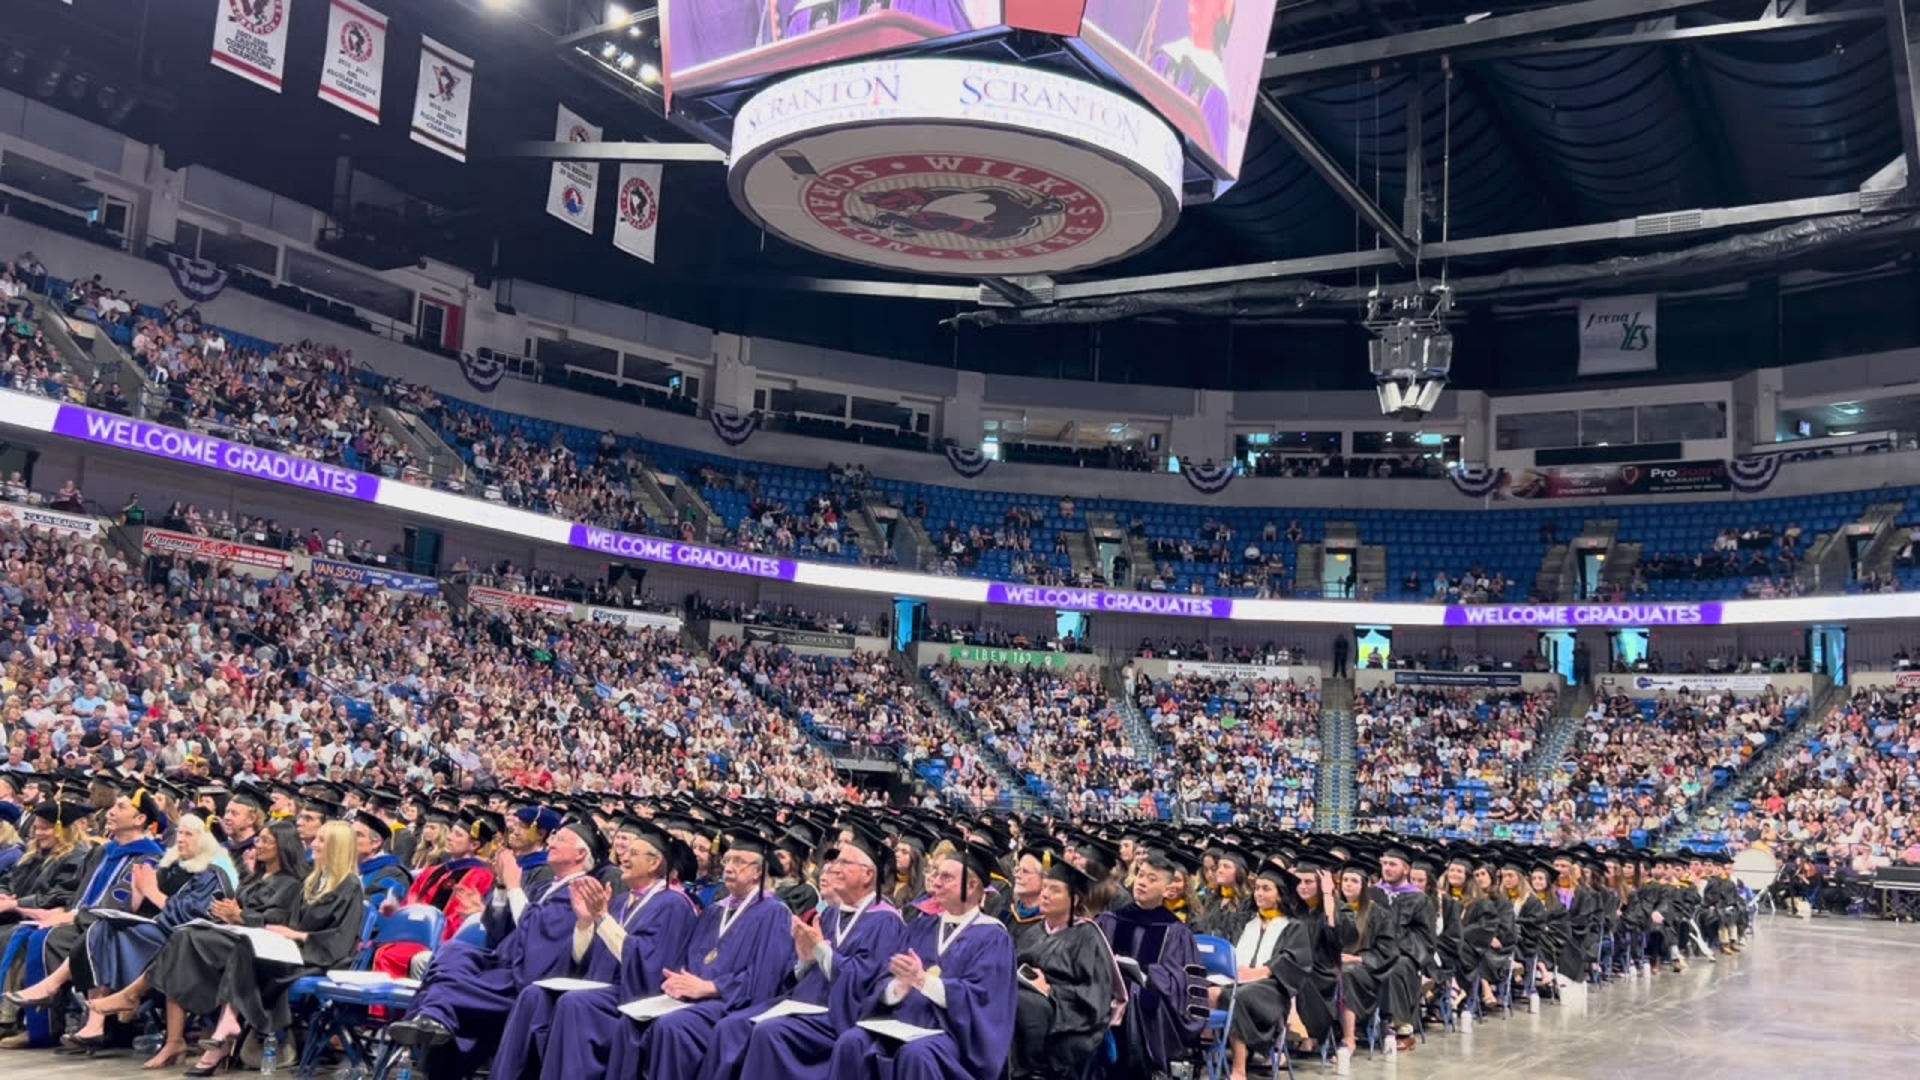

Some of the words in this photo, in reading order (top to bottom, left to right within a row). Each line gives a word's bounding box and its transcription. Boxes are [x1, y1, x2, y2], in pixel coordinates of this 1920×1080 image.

[226, 37, 276, 65] CONFERENCE
[227, 46, 272, 70] CHAMPIONS
[235, 35, 268, 54] EASTERN
[336, 80, 366, 98] CHAMPION
[959, 75, 1141, 146] SCRANTON
[86, 414, 219, 465] WELCOME
[224, 447, 358, 494] GRADUATES
[585, 530, 673, 560] WELCOME
[677, 546, 780, 576] GRADUATES
[1004, 586, 1099, 608] WELCOME
[1103, 594, 1213, 615] GRADUATES
[1464, 606, 1568, 624] WELCOME
[1573, 605, 1702, 623] GRADUATES
